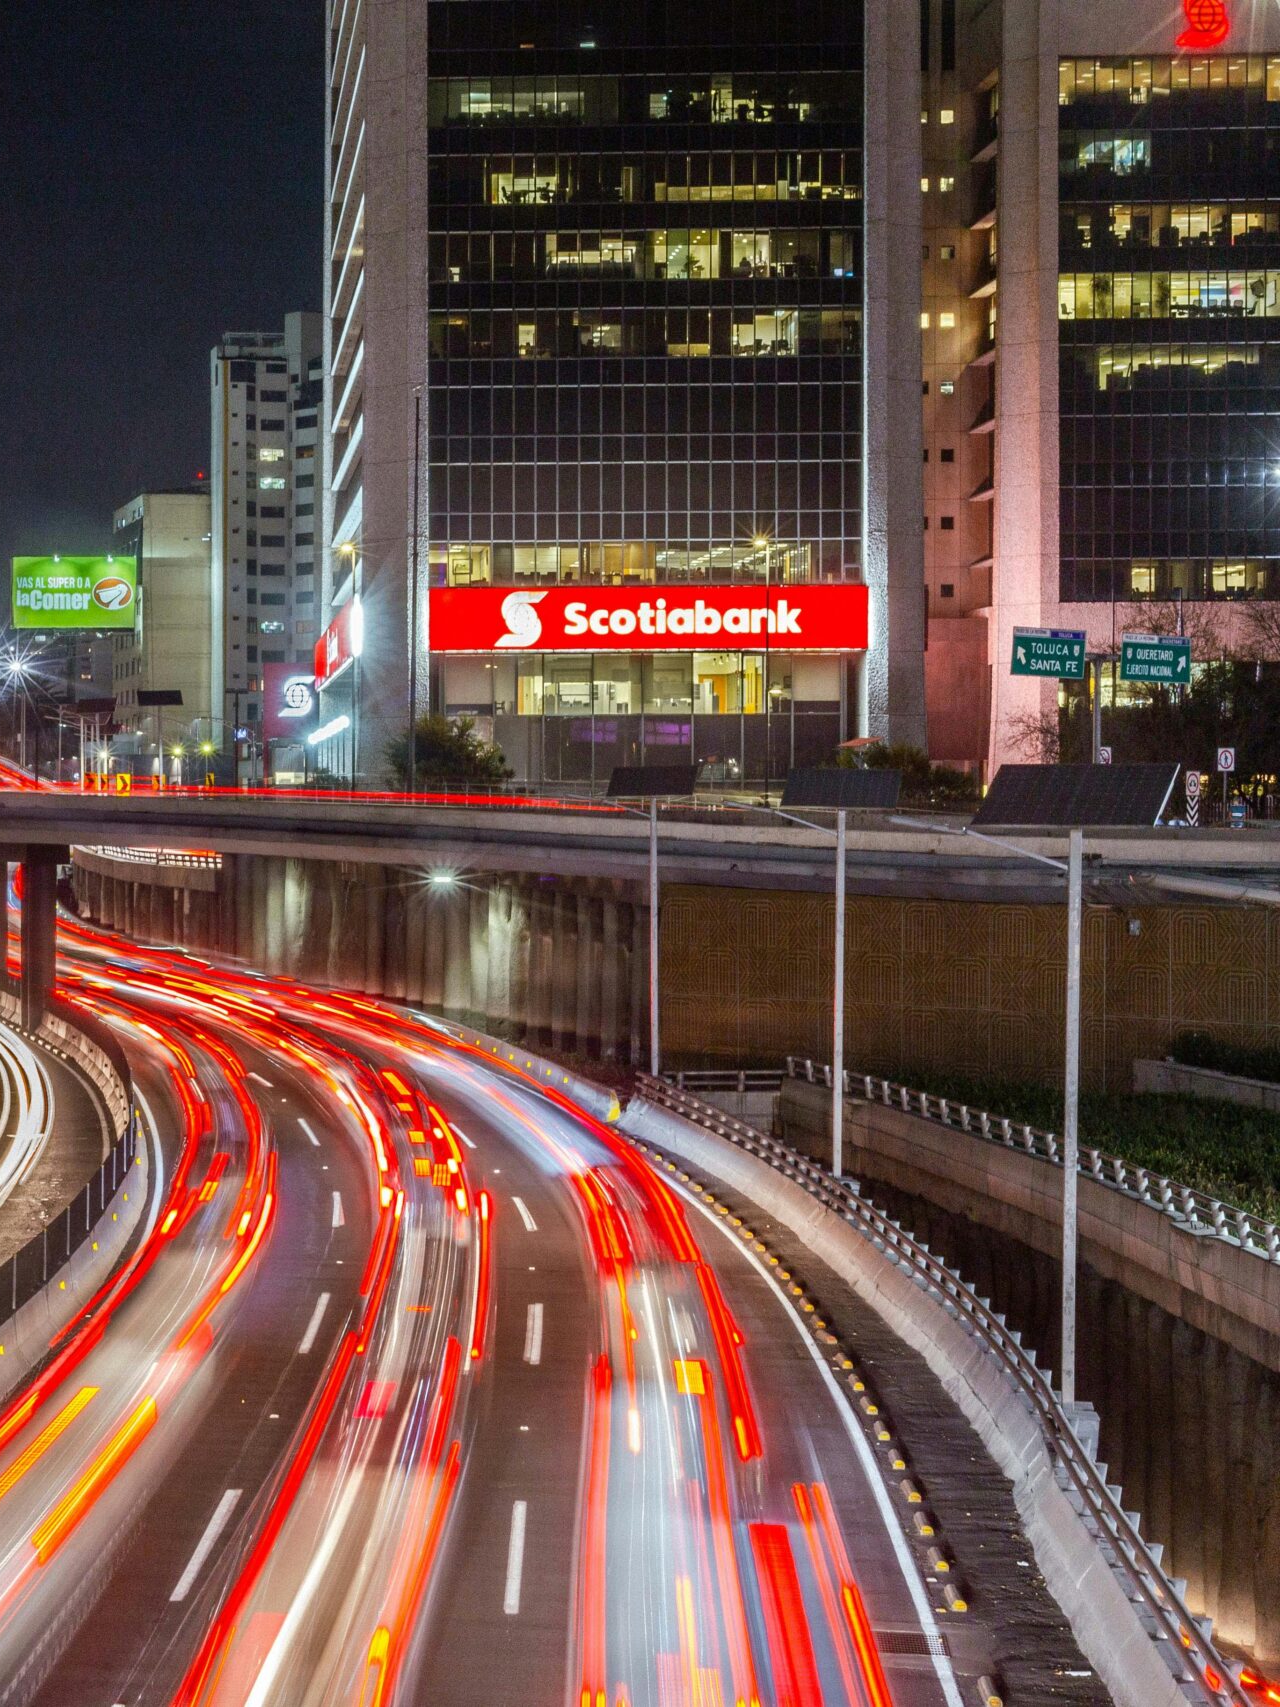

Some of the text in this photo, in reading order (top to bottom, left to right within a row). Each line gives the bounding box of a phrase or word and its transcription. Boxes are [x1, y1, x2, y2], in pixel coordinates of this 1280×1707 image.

[17, 576, 33, 589] VAS
[35, 576, 45, 589] AL
[47, 576, 75, 589] SUPER
[85, 577, 91, 589] A
[16, 590, 91, 611] laComer
[564, 598, 802, 635] Scotiabank
[1031, 642, 1069, 656] TOLUCA
[1136, 648, 1174, 662] QUERETARO
[1029, 659, 1078, 673] SANTA FE
[1126, 664, 1173, 677] EJERCITO NACIONAL
